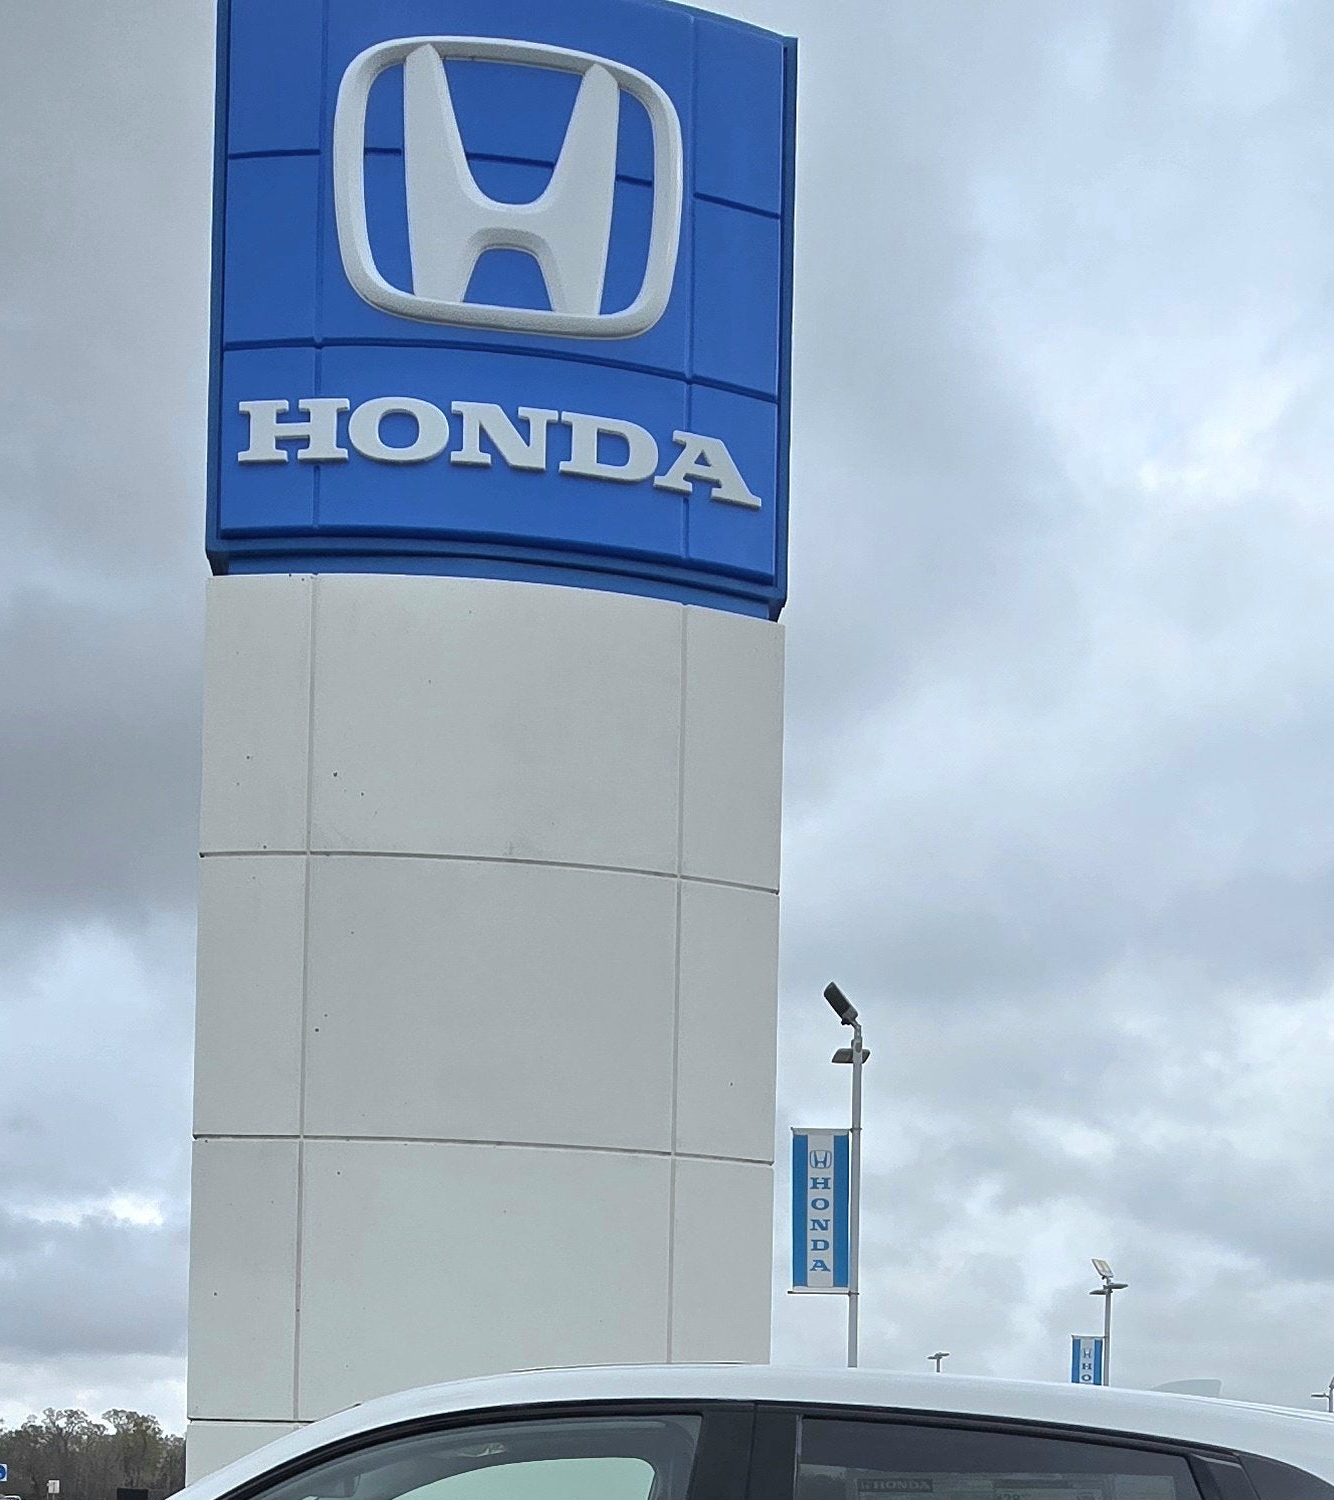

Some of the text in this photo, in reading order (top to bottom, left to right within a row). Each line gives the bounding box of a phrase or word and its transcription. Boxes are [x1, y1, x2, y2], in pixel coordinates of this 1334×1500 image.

[238, 396, 762, 509] HONDA
[809, 1176, 832, 1273] HONDA
[873, 1480, 932, 1490] HONDA
